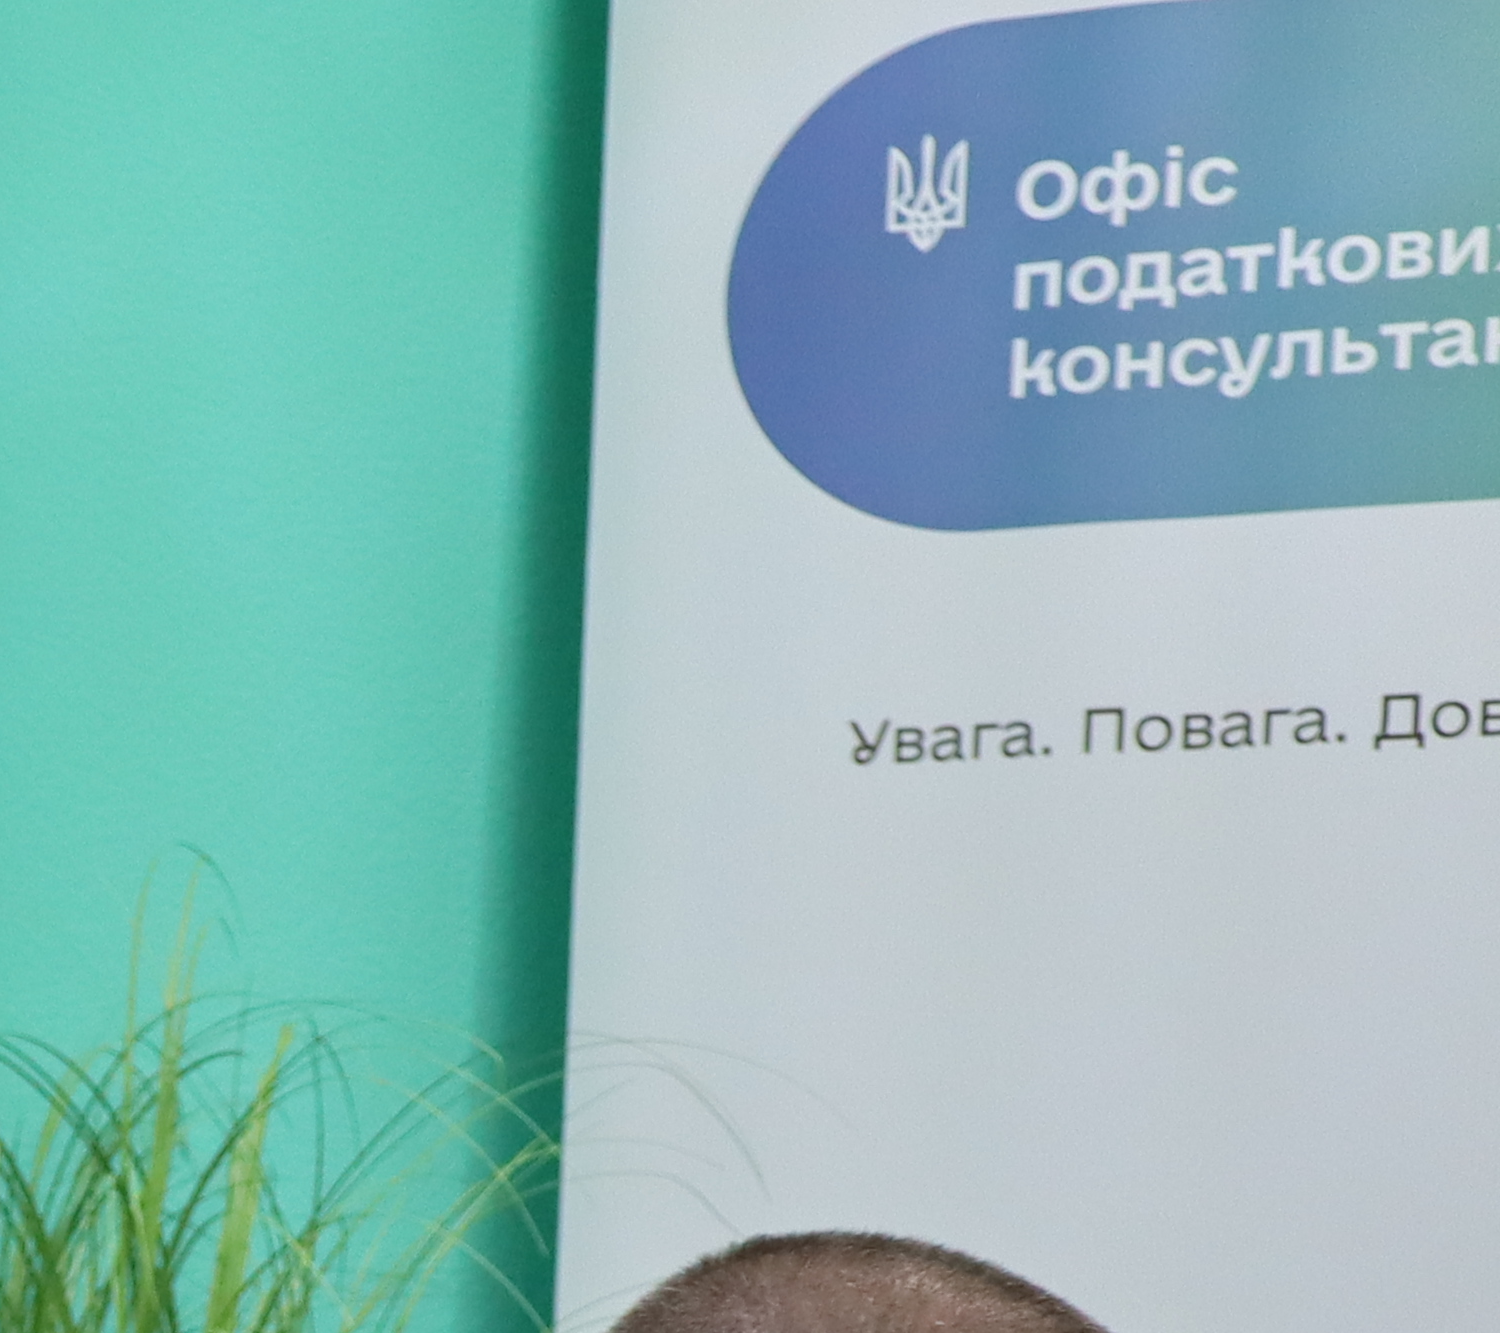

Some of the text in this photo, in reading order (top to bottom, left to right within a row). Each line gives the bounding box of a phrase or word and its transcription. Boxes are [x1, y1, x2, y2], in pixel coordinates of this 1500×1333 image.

[1015, 145, 1240, 228] Офіс
[1011, 224, 1500, 311] податкови
[849, 718, 1053, 766] Увага.
[1083, 706, 1347, 754] Повага.
